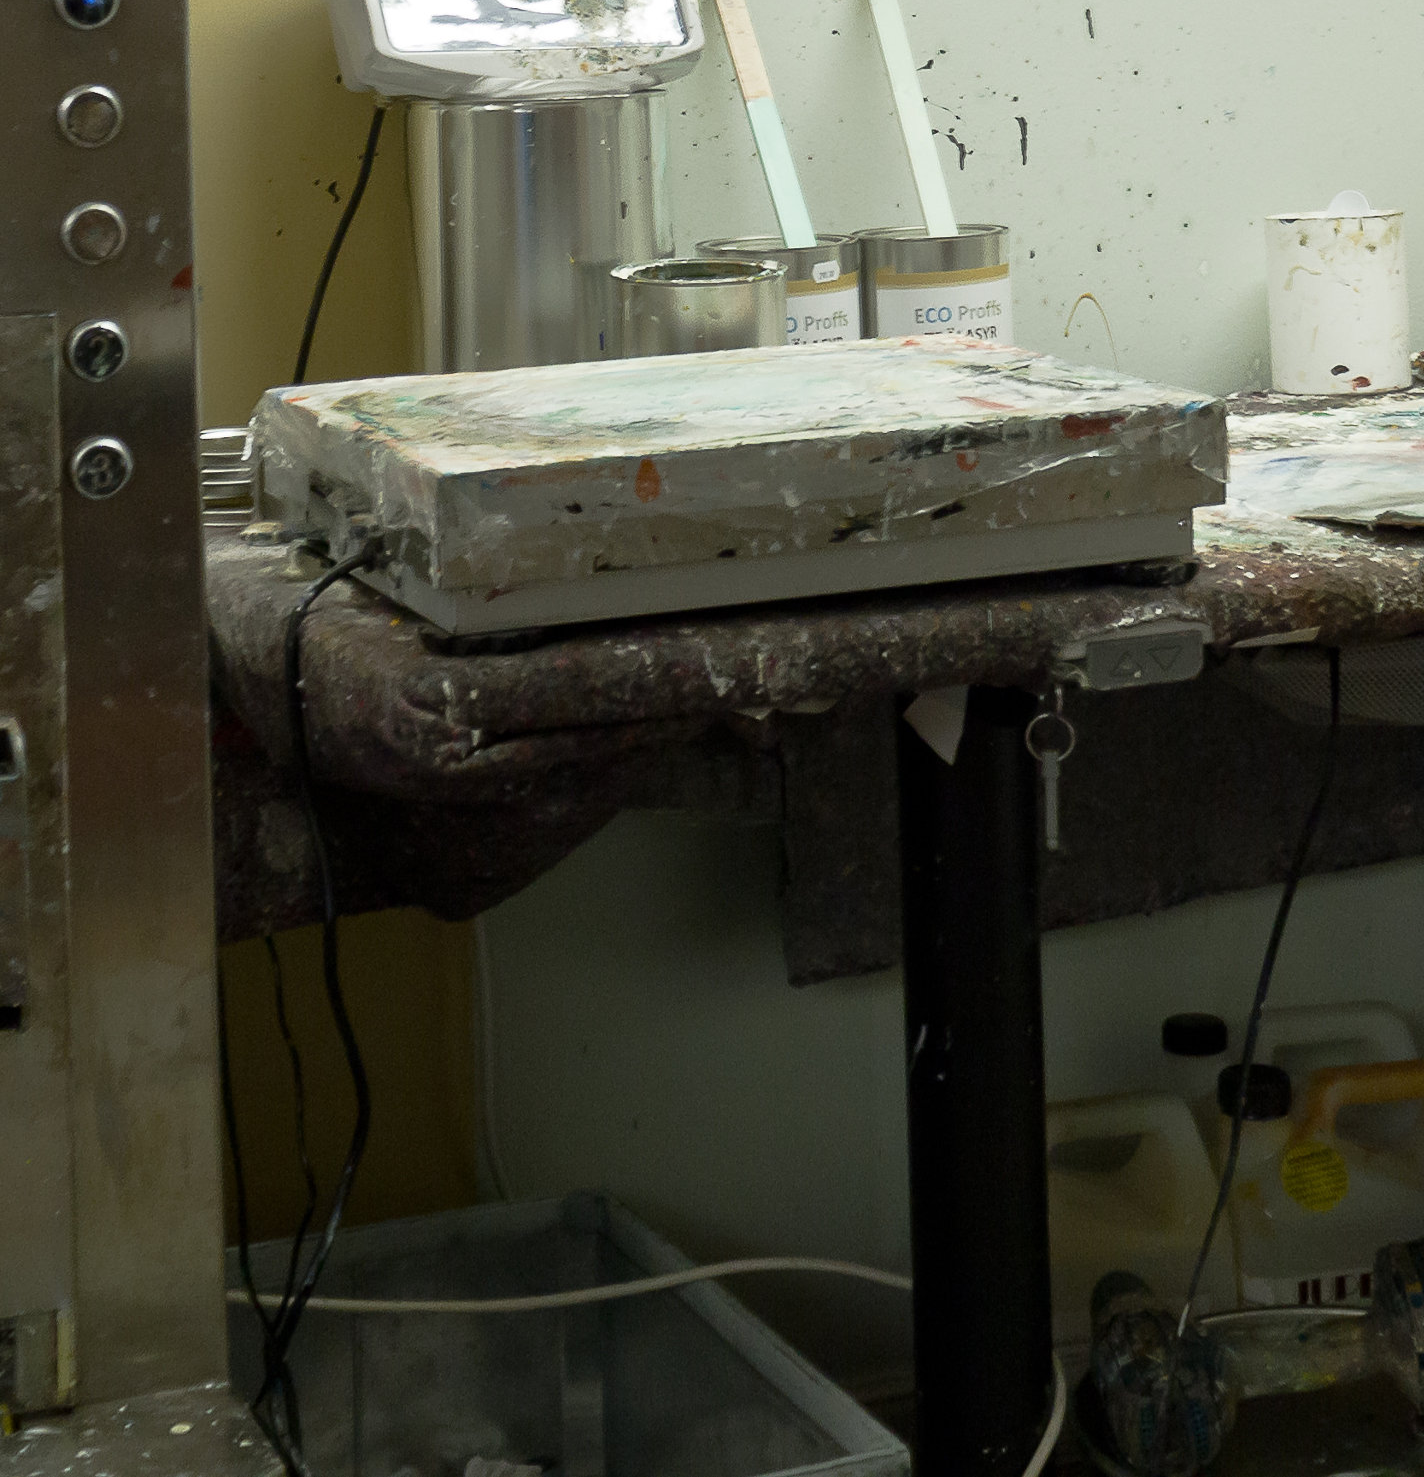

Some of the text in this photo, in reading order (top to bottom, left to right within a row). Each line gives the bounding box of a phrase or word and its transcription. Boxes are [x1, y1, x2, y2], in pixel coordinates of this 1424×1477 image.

[804, 310, 849, 332] Proffs
[915, 300, 1002, 324] ECO Proffs
